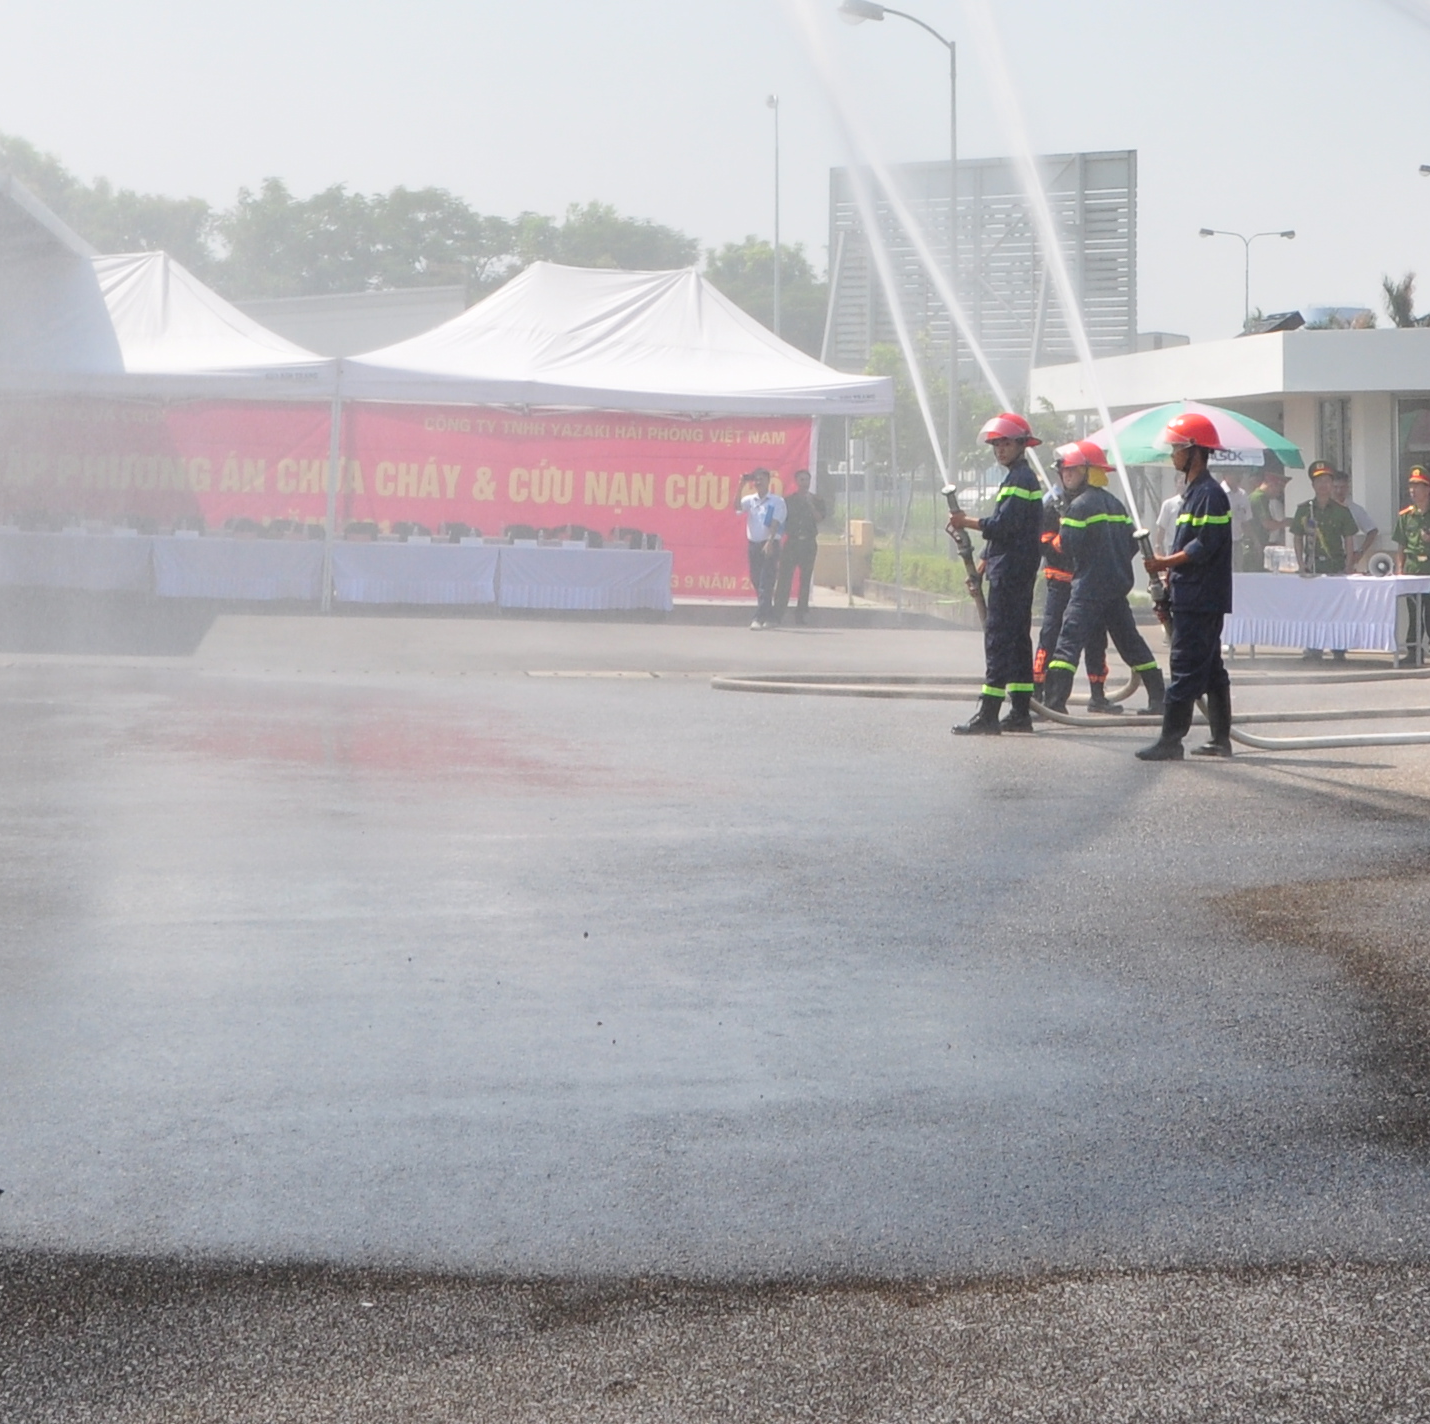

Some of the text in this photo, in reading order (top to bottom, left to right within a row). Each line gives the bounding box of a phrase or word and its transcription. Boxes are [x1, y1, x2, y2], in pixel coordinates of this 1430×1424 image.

[425, 414, 785, 447] CÔNG TY TNHH YAZAKI HẢI PHÒNG VIỆT NAM
[55, 451, 212, 492] PHƯƠNG
[219, 450, 266, 493] ÁN
[374, 456, 462, 499] CHÁY
[473, 466, 496, 501] &
[508, 460, 574, 506] CỨU
[584, 471, 654, 514] NẠN
[665, 464, 730, 511] CỨU
[684, 575, 694, 588] 9
[698, 572, 736, 590] NĂM
